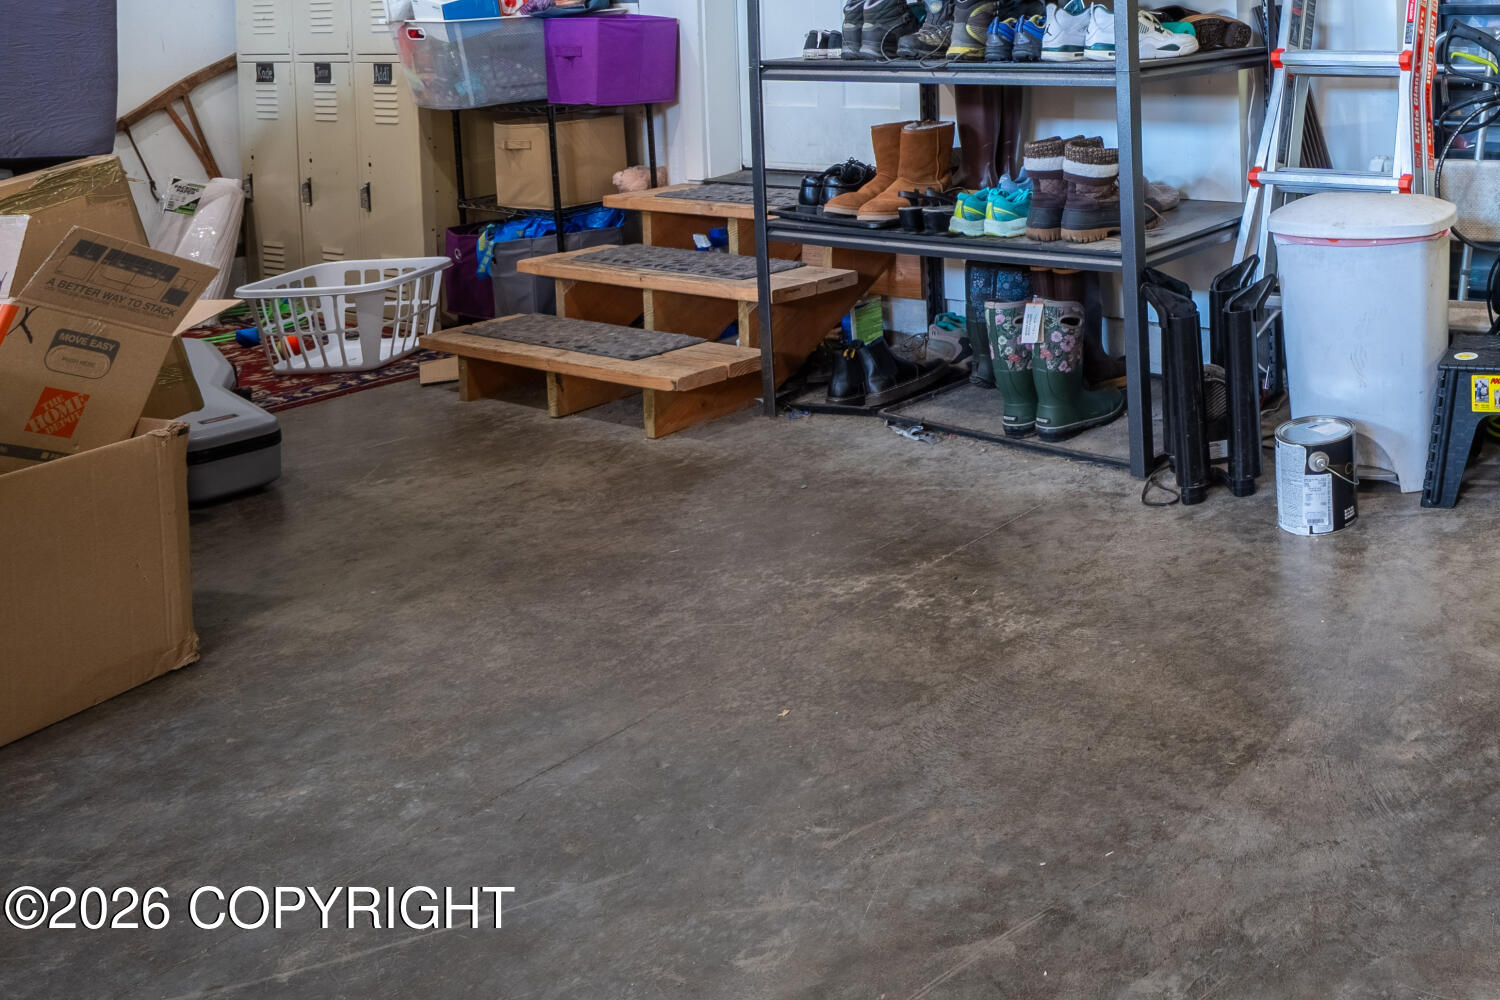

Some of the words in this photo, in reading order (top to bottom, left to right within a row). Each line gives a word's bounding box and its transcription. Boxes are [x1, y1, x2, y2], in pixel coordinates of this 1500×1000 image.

[46, 277, 56, 287] A
[57, 280, 101, 298] BETTER
[103, 291, 127, 305] WAY
[128, 297, 142, 309] TO
[143, 302, 177, 317] STACK
[60, 332, 88, 346] MOVE
[89, 340, 116, 352] EASY
